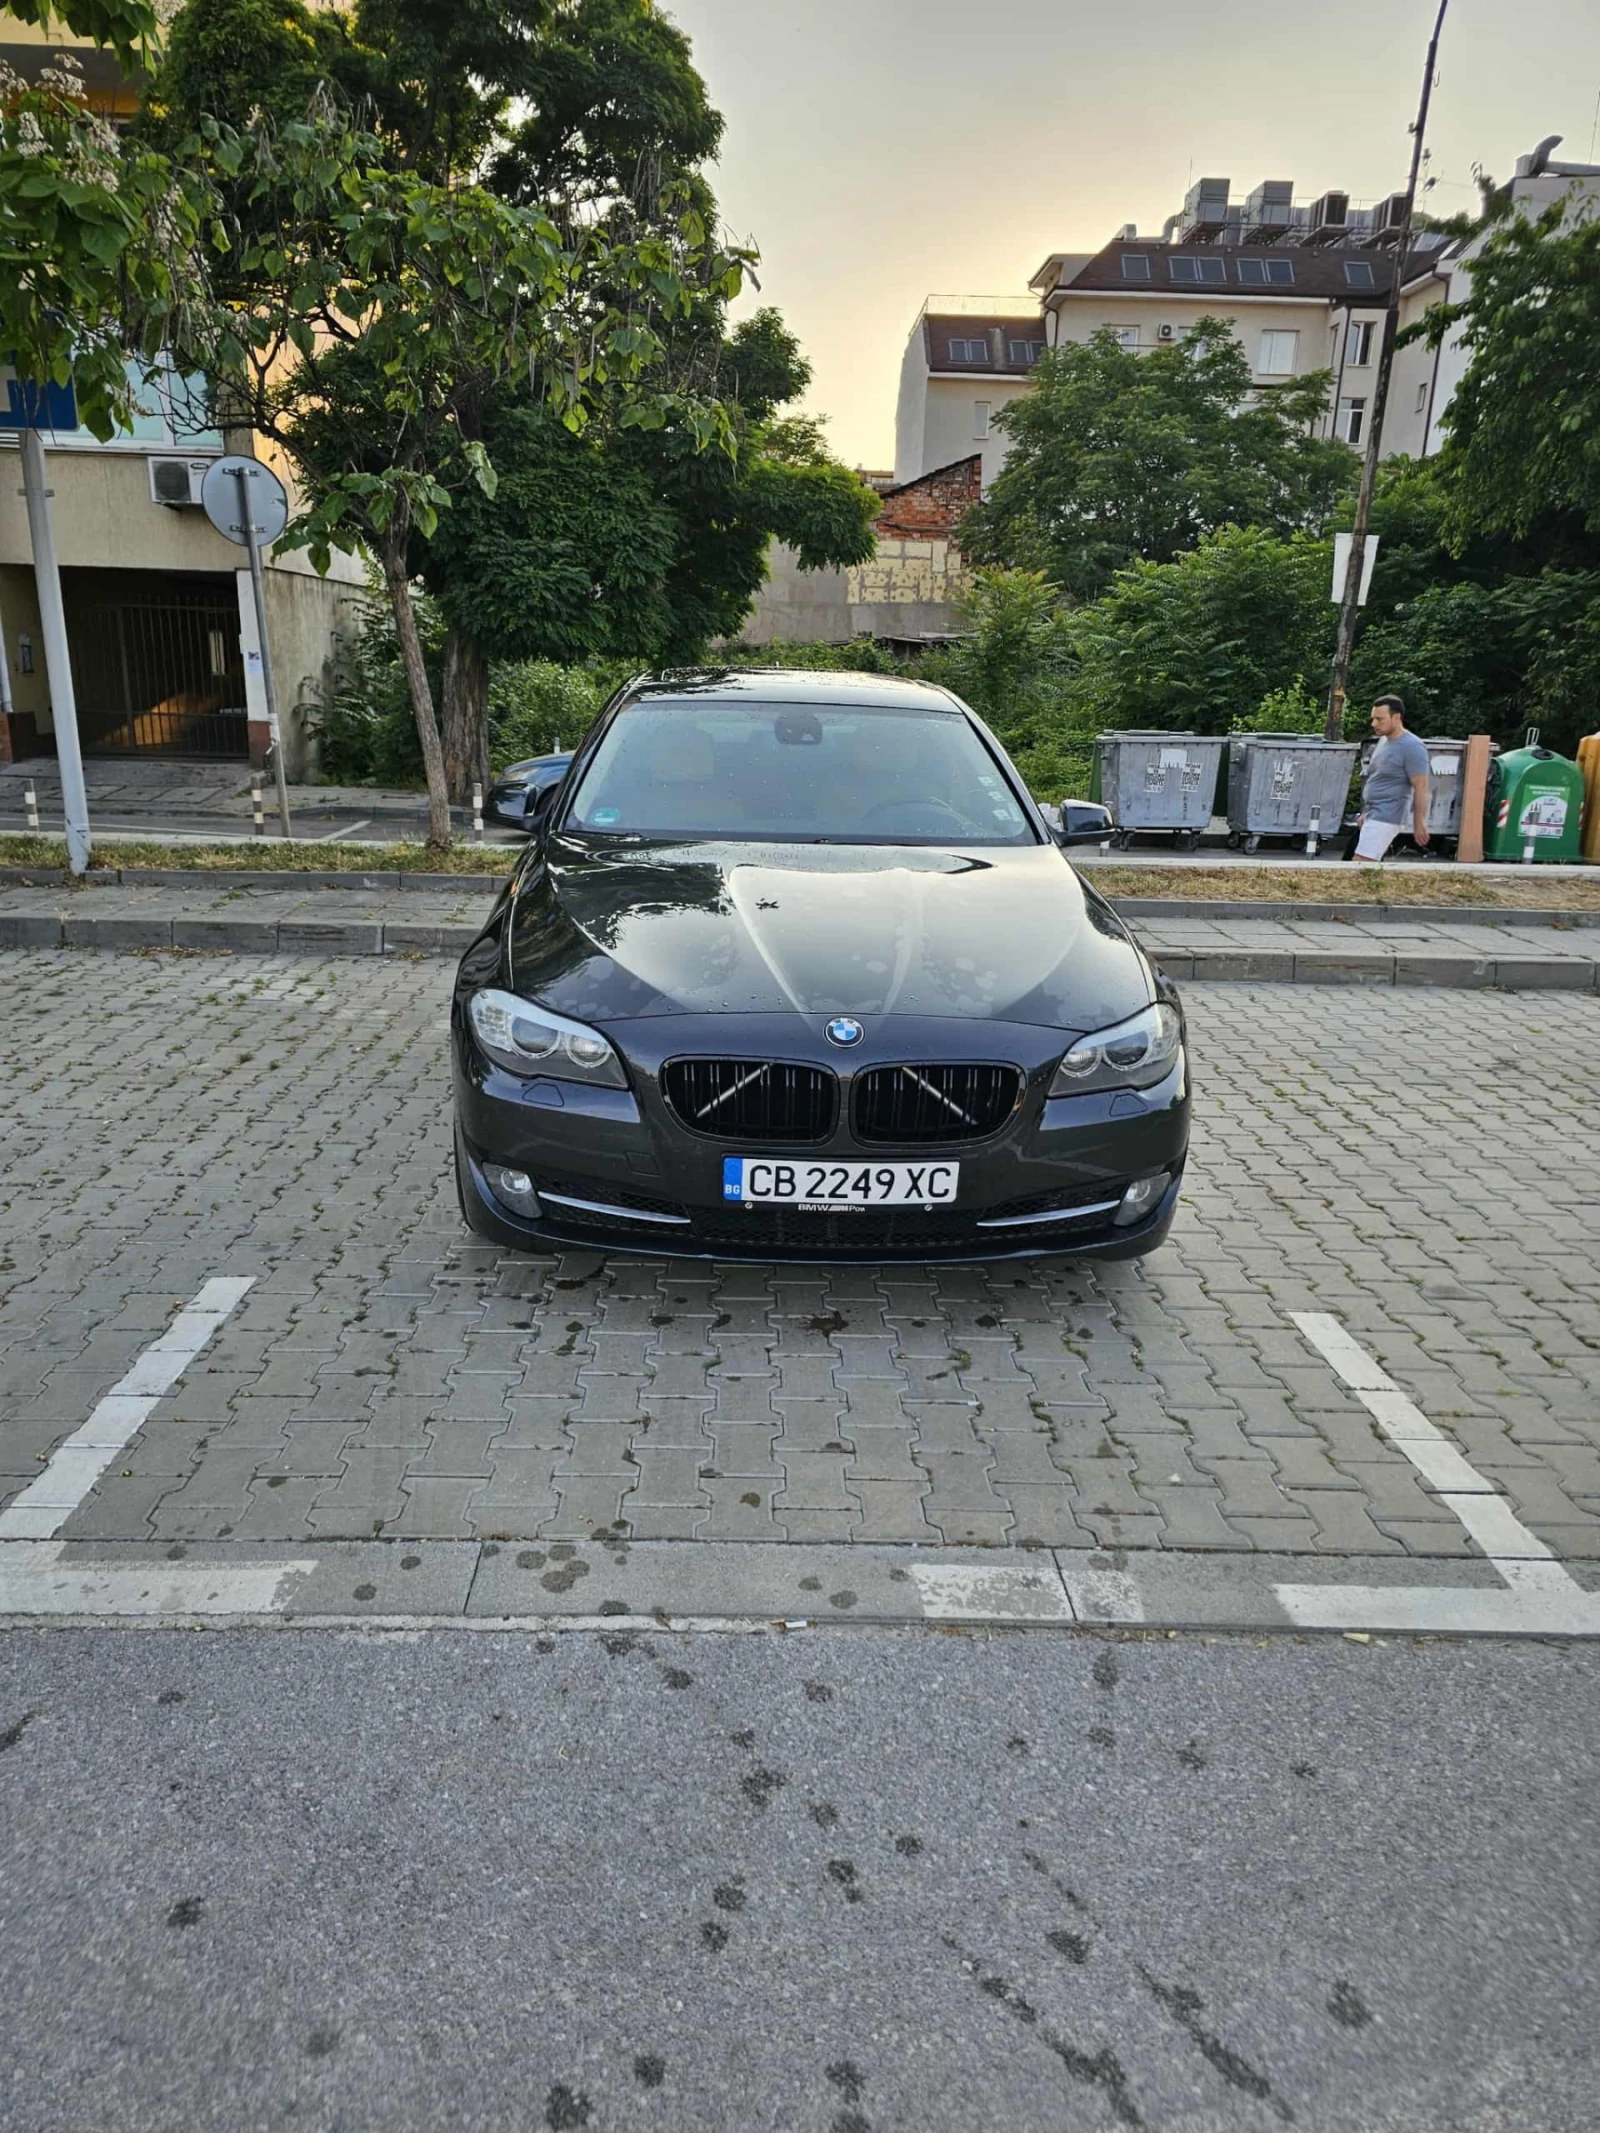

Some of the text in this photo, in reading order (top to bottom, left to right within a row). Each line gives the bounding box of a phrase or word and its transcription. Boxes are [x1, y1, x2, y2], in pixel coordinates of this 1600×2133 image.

[749, 1164, 951, 1199] CB 2249 XC
[725, 1184, 741, 1195] BG
[798, 1203, 829, 1212] BMW
